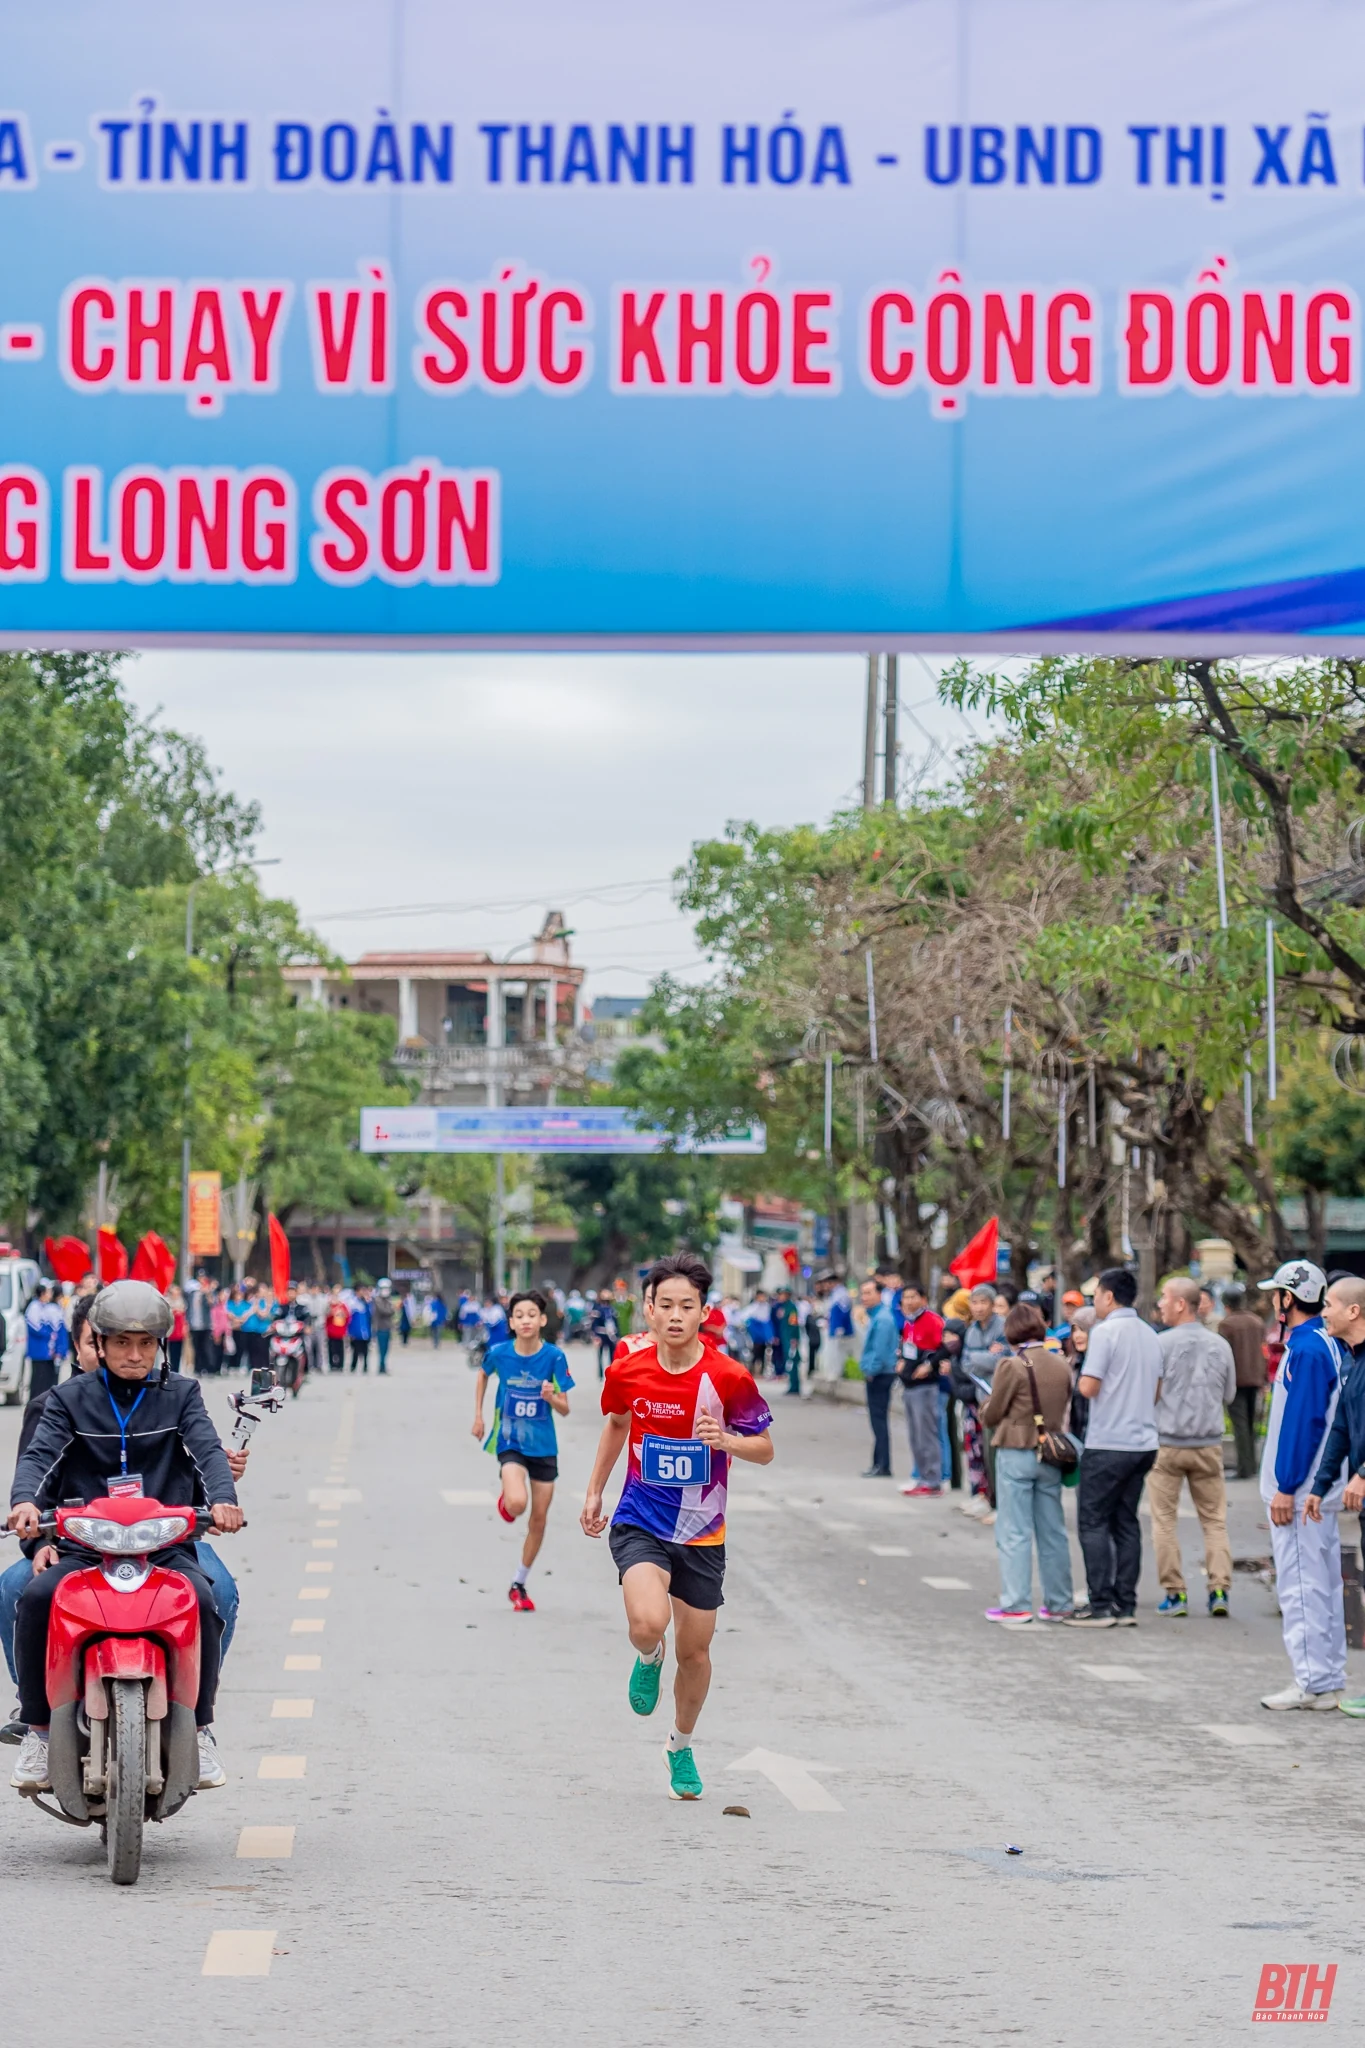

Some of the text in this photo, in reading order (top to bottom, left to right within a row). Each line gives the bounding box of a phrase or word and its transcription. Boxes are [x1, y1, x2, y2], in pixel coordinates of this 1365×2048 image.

[99, 97, 249, 182] TỈNH
[273, 108, 454, 183] ĐOÀN
[479, 124, 695, 184] THANH
[721, 110, 852, 186] HÓA
[924, 126, 1102, 186] UBND
[1128, 126, 1226, 200] THỊ
[1252, 111, 1338, 186] XÃ
[69, 287, 284, 406] CHẠY
[316, 268, 388, 383] VÌ
[423, 269, 584, 385] SỨC
[620, 255, 832, 386] KHỎE
[869, 271, 1092, 409] CỘNG
[1124, 256, 1351, 386] ĐỒNG
[74, 476, 287, 572] LONG
[322, 468, 490, 573] SƠN
[515, 1401, 537, 1417] 66
[652, 1402, 681, 1410] VIETNAM
[652, 1408, 685, 1416] TRIATHLON
[658, 1454, 692, 1480] 50
